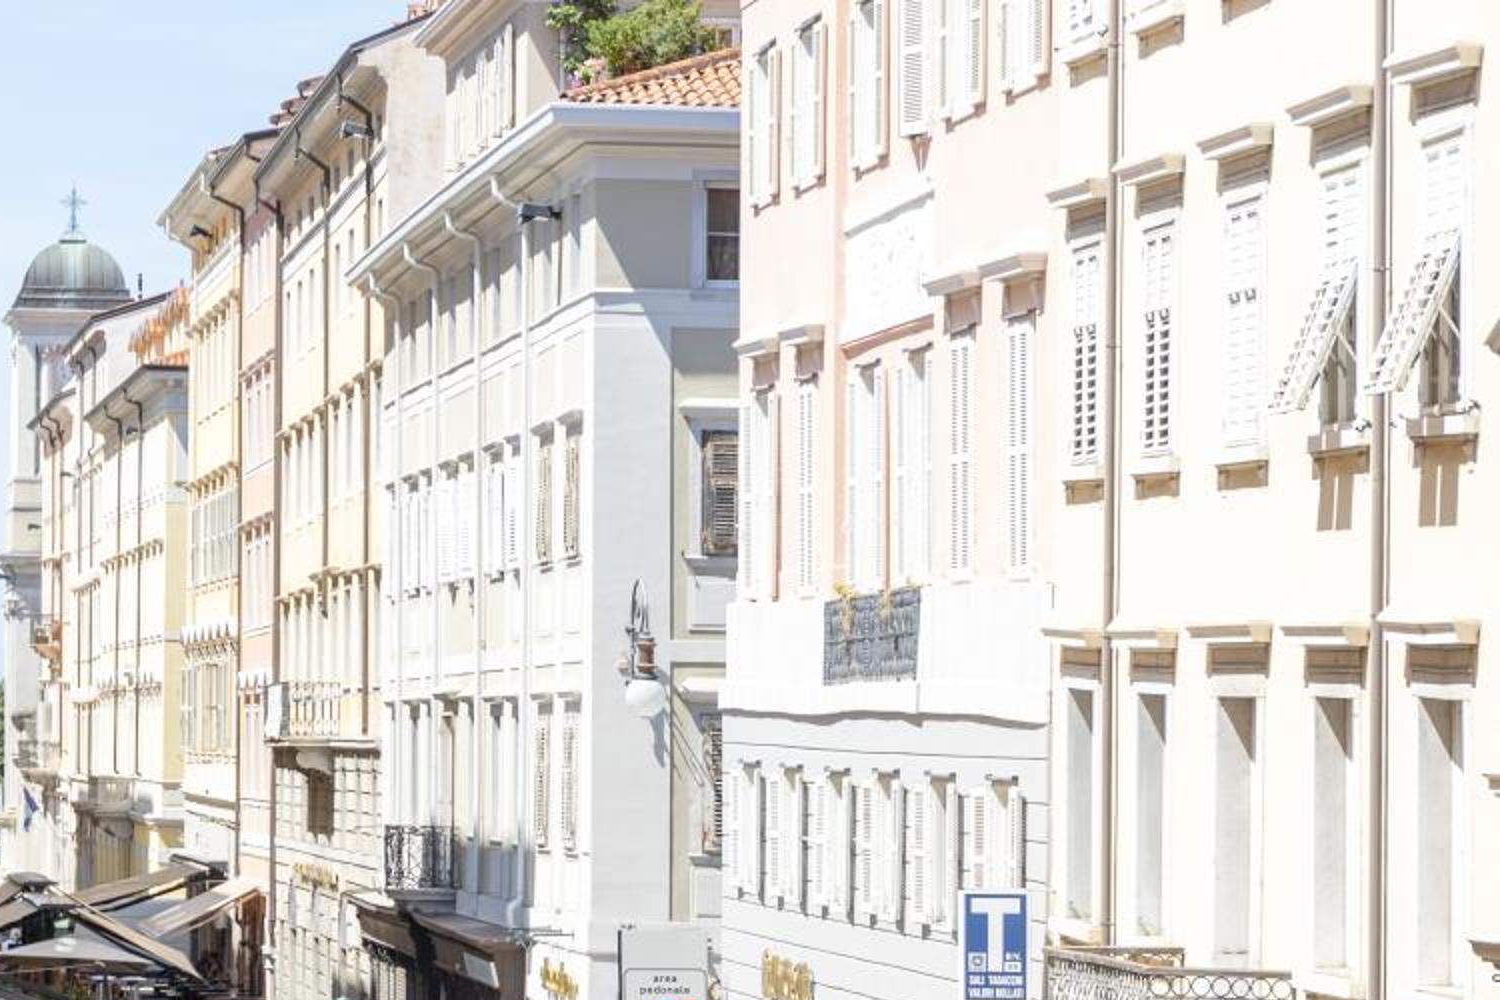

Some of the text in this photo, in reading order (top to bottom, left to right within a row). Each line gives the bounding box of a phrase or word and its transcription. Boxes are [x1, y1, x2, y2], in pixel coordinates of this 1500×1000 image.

[971, 898, 1020, 972] T
[653, 975, 677, 983] area
[639, 986, 690, 995] pedonale
